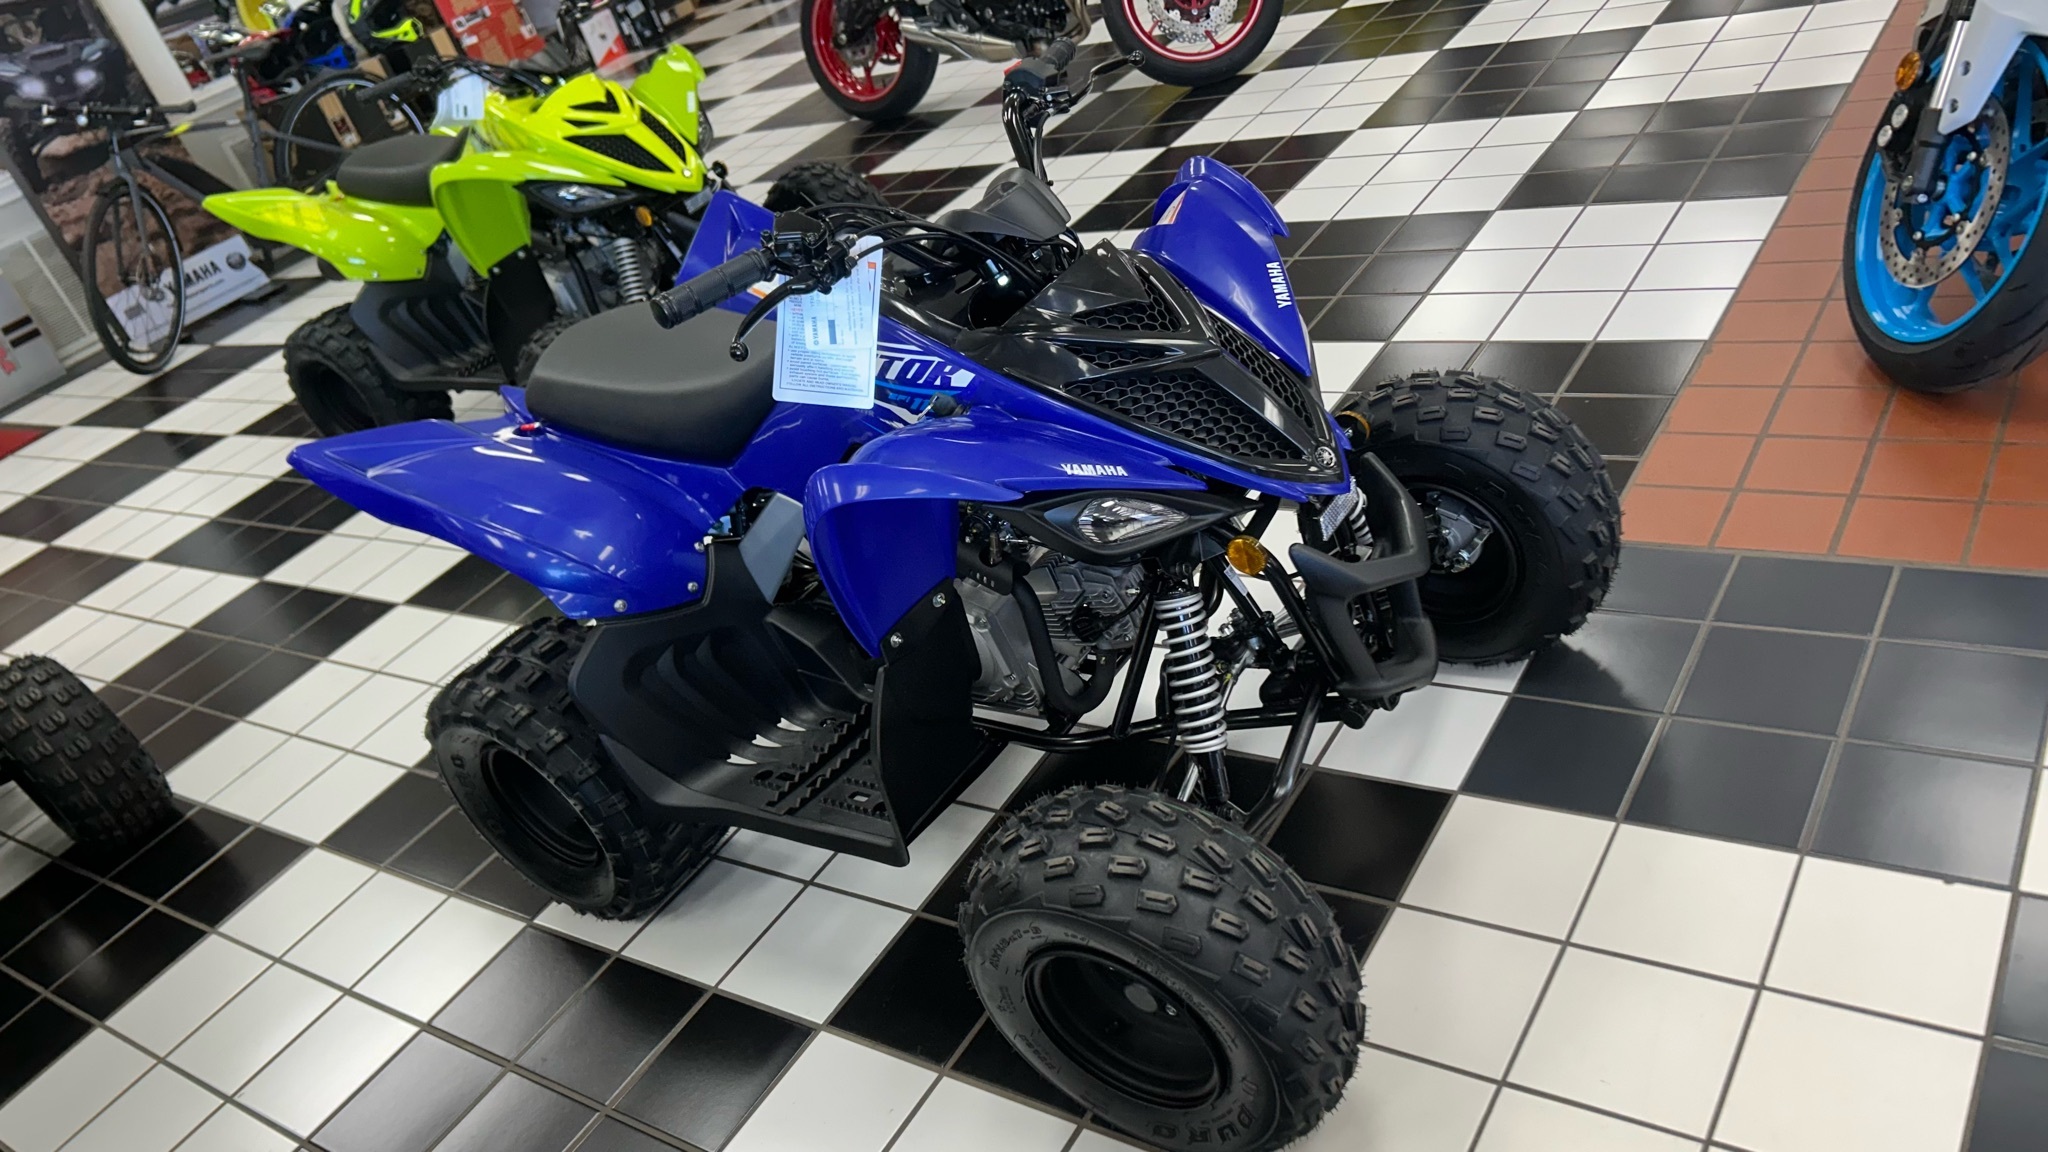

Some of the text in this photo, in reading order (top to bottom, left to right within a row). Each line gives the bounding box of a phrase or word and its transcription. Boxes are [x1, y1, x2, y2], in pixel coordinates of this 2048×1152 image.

[163, 260, 222, 292] YMAHA
[1266, 261, 1292, 309] YAMAHA
[875, 353, 962, 387] TOR
[1060, 463, 1129, 477] YAMAHA
